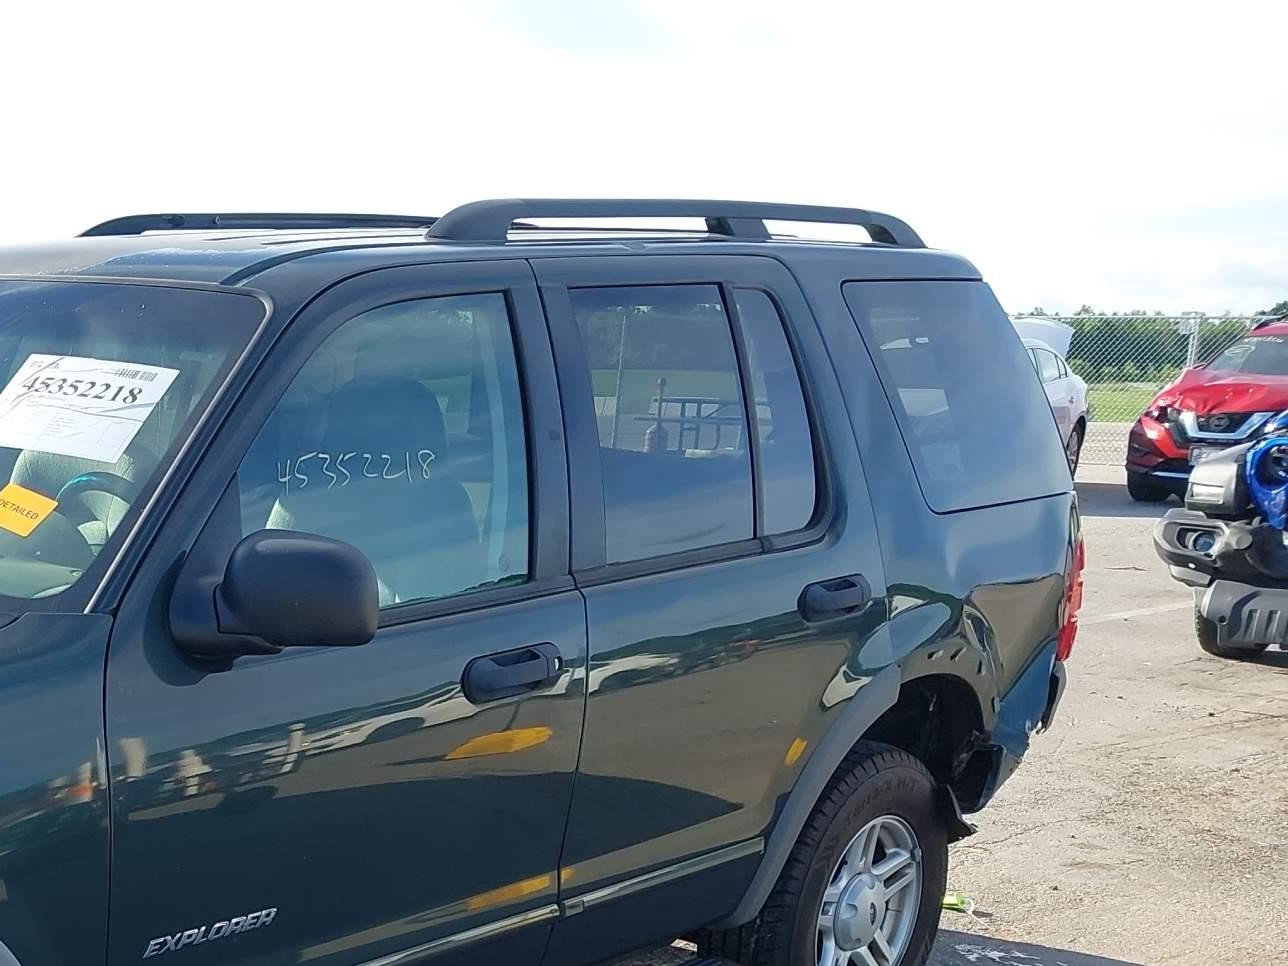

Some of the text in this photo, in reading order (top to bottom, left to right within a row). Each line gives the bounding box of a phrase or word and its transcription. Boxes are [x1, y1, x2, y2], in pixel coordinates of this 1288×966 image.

[21, 375, 143, 405] 45352218
[277, 449, 436, 496] 45352218
[142, 907, 278, 959] EXPLORER
